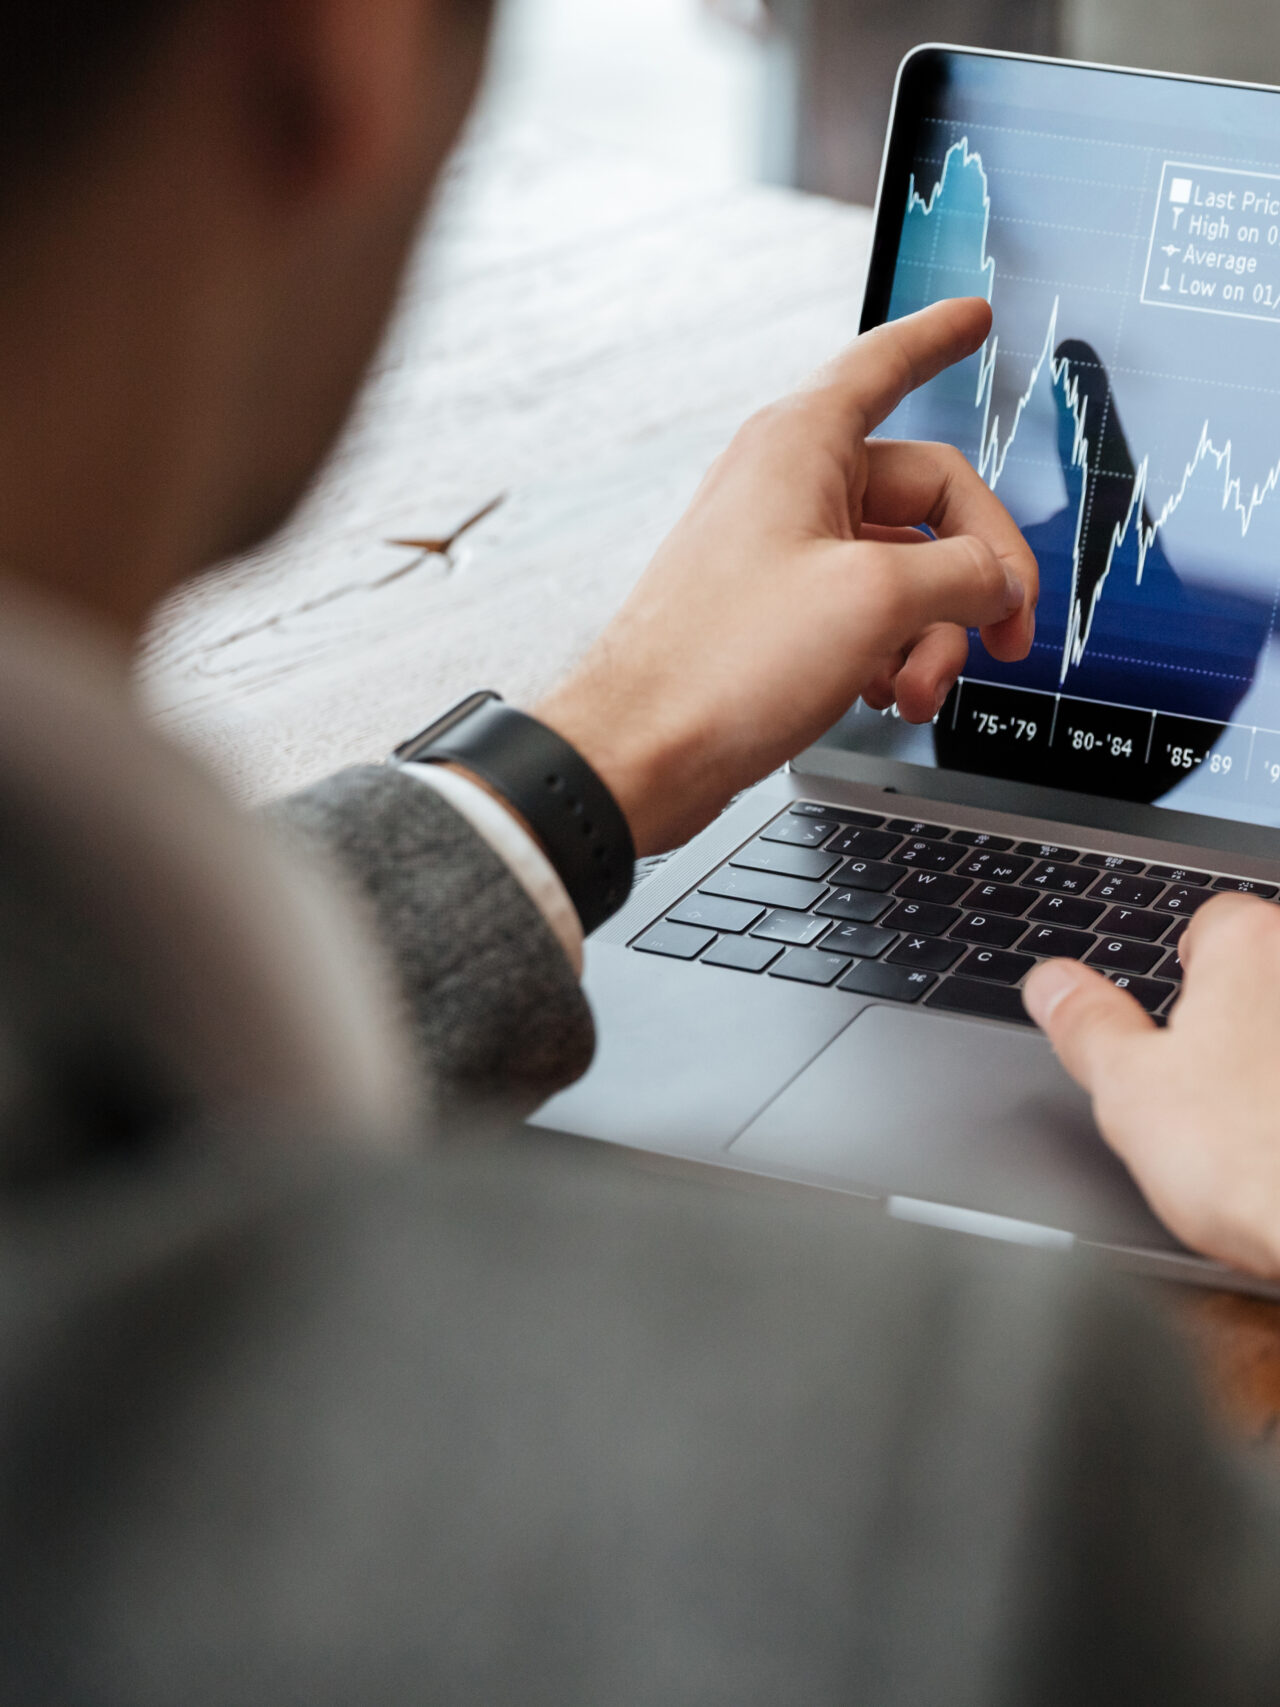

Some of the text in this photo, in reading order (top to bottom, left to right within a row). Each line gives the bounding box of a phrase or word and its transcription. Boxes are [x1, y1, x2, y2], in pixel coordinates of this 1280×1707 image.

[1194, 185, 1235, 210] Last
[1188, 214, 1229, 242] High
[1237, 226, 1259, 244] on
[1183, 243, 1257, 275] Average
[1179, 273, 1216, 297] Low
[1223, 285, 1244, 301] on
[903, 851, 917, 860] 2
[851, 863, 867, 872] Q
[968, 863, 982, 872] 3
[917, 873, 937, 884] W
[1034, 875, 1048, 883] 4
[981, 885, 997, 895] E
[1100, 886, 1115, 895] 5
[837, 893, 852, 902] A
[1048, 898, 1063, 907] R
[1168, 899, 1182, 908] 6
[904, 904, 920, 914] S
[1119, 910, 1132, 919] T
[970, 917, 986, 926] D
[840, 926, 857, 936] Z
[1037, 929, 1052, 938] F
[908, 938, 926, 949] X
[1107, 942, 1123, 952] G
[977, 952, 993, 962] C
[1114, 977, 1130, 988] B
